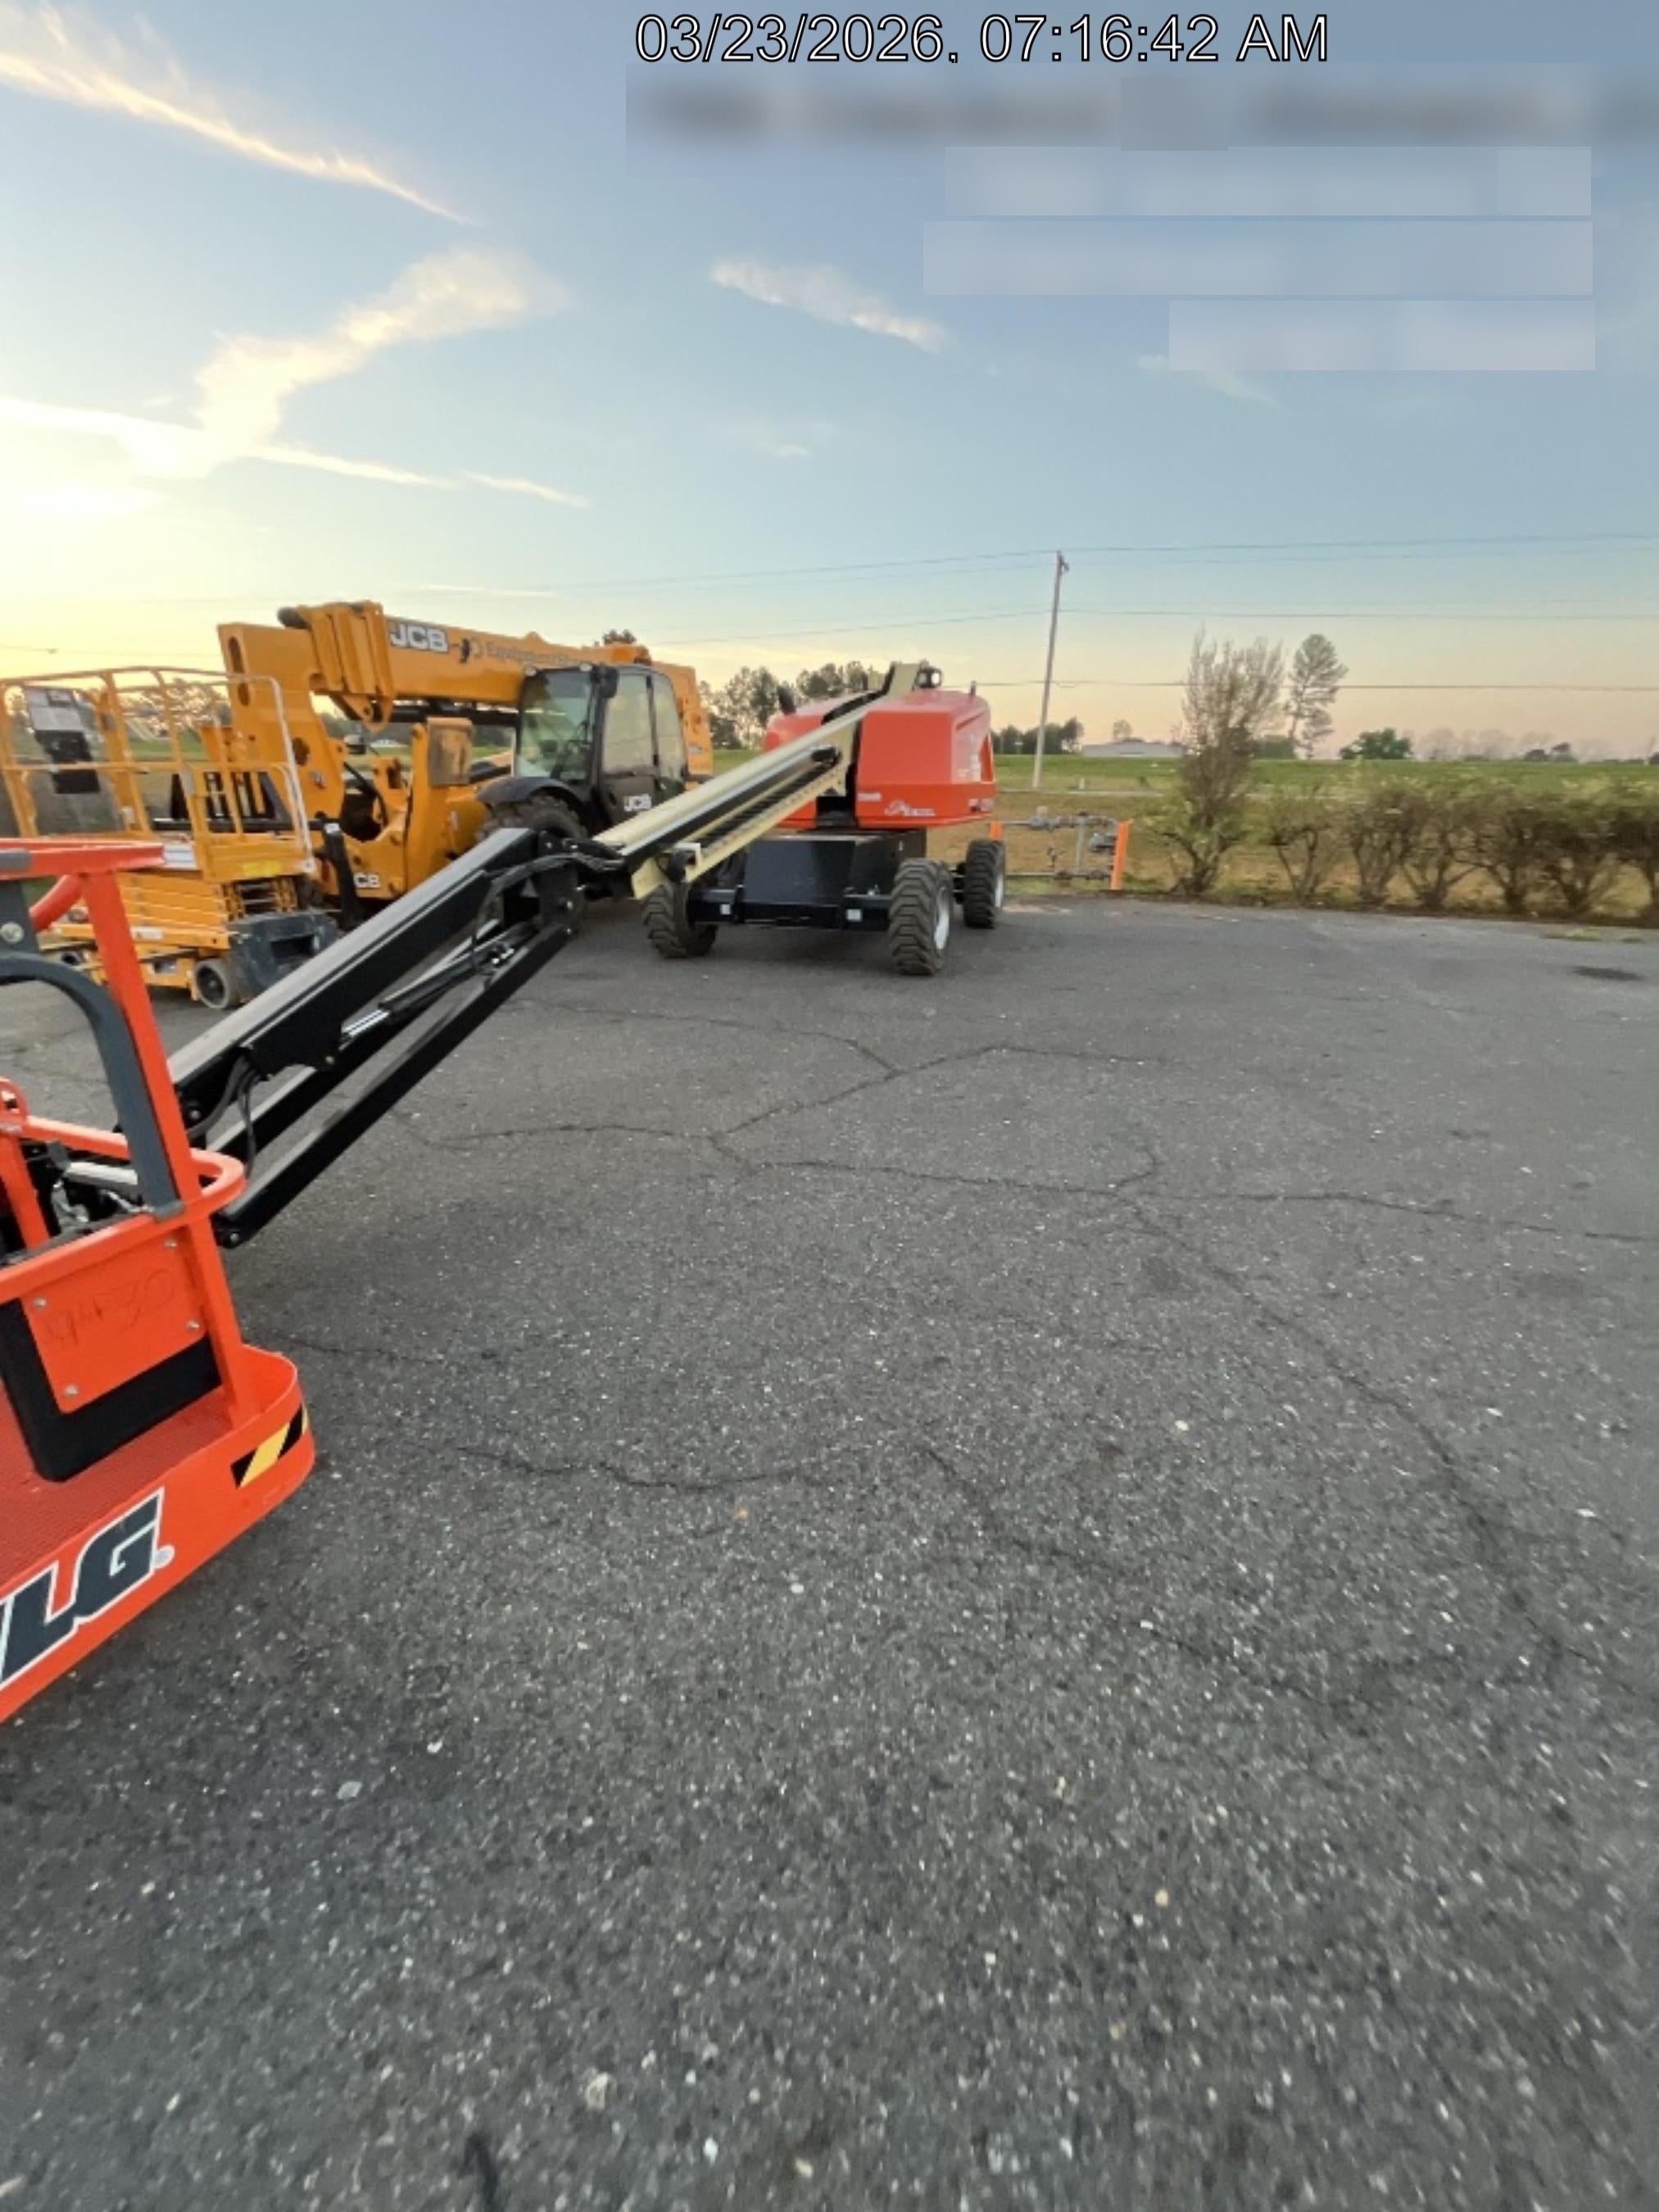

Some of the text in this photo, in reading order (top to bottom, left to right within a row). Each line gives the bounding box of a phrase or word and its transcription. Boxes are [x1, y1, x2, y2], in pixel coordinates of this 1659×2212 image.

[390, 623, 449, 653] JCB
[623, 793, 652, 812] JCB
[353, 872, 380, 889] CB
[0, 1486, 165, 1691] LG
